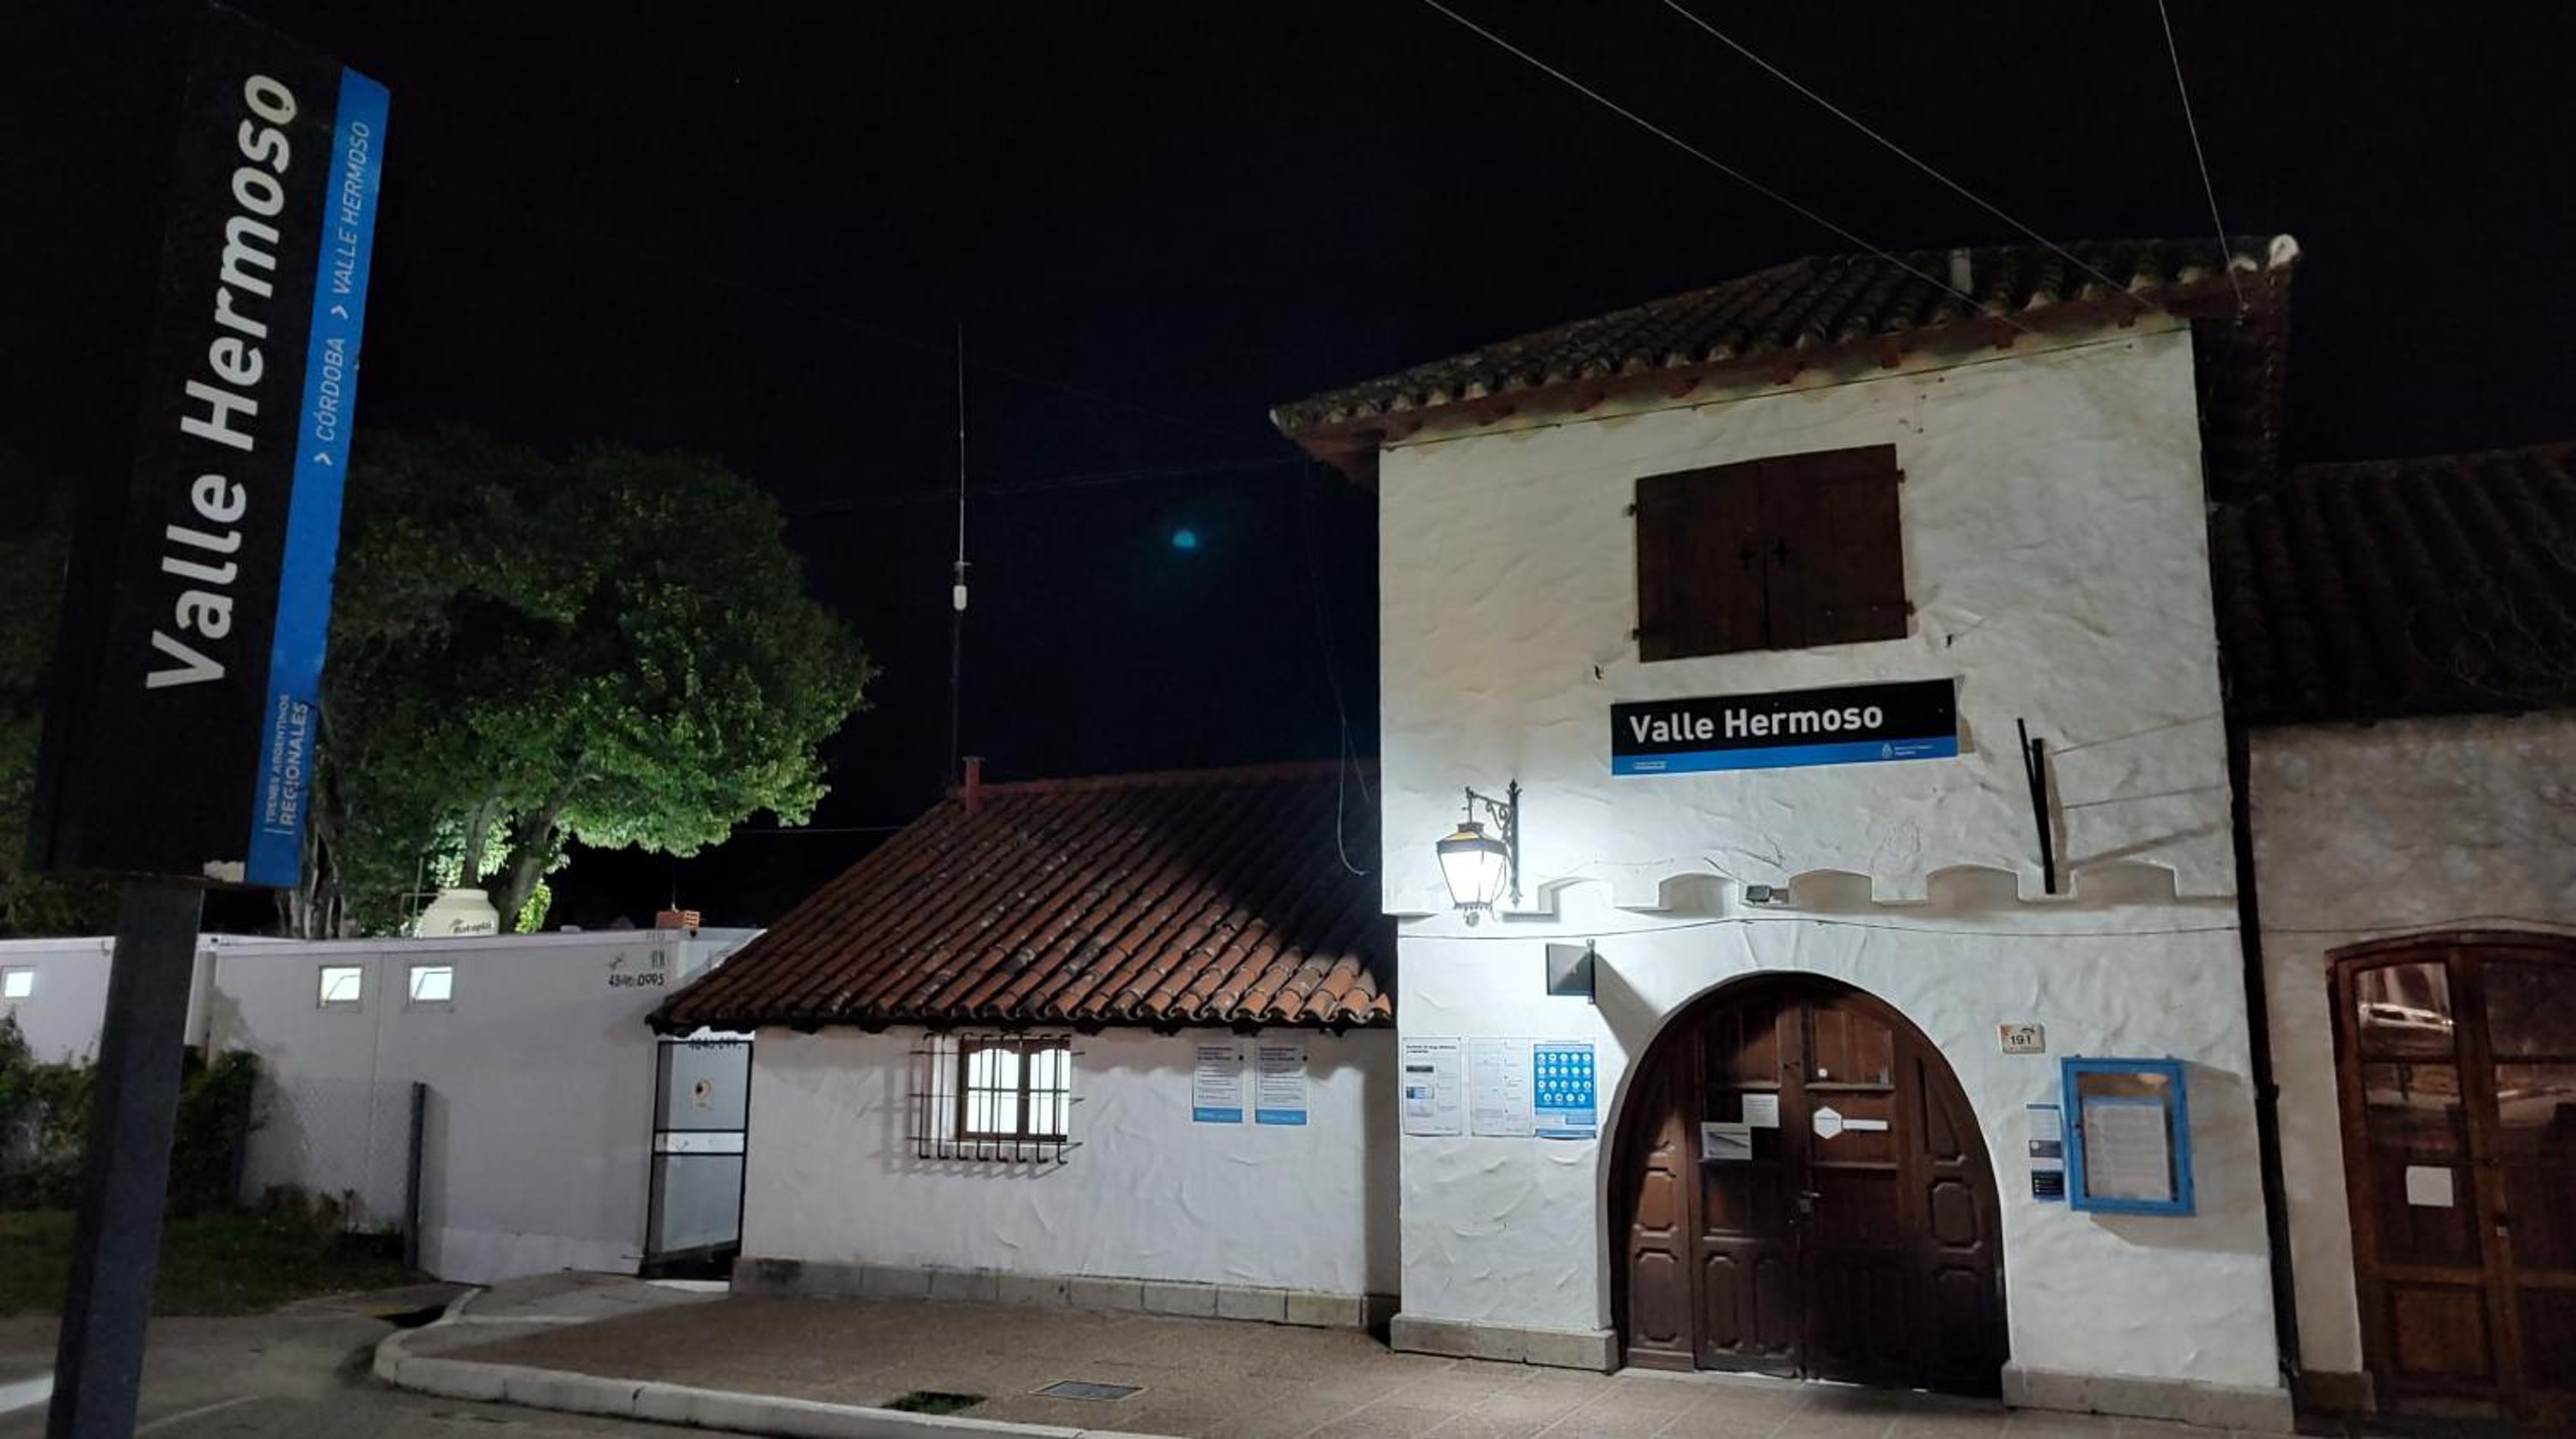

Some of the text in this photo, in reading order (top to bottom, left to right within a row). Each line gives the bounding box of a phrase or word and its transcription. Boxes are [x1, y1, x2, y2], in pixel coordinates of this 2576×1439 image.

[317, 121, 370, 441] CÓRDOBA VALLE HERMOSO
[146, 75, 298, 689] Valle Hermoso
[281, 702, 308, 825] REGIONALES
[1629, 706, 1883, 744] Valle Hermoso
[2011, 1034, 2032, 1045] 191
